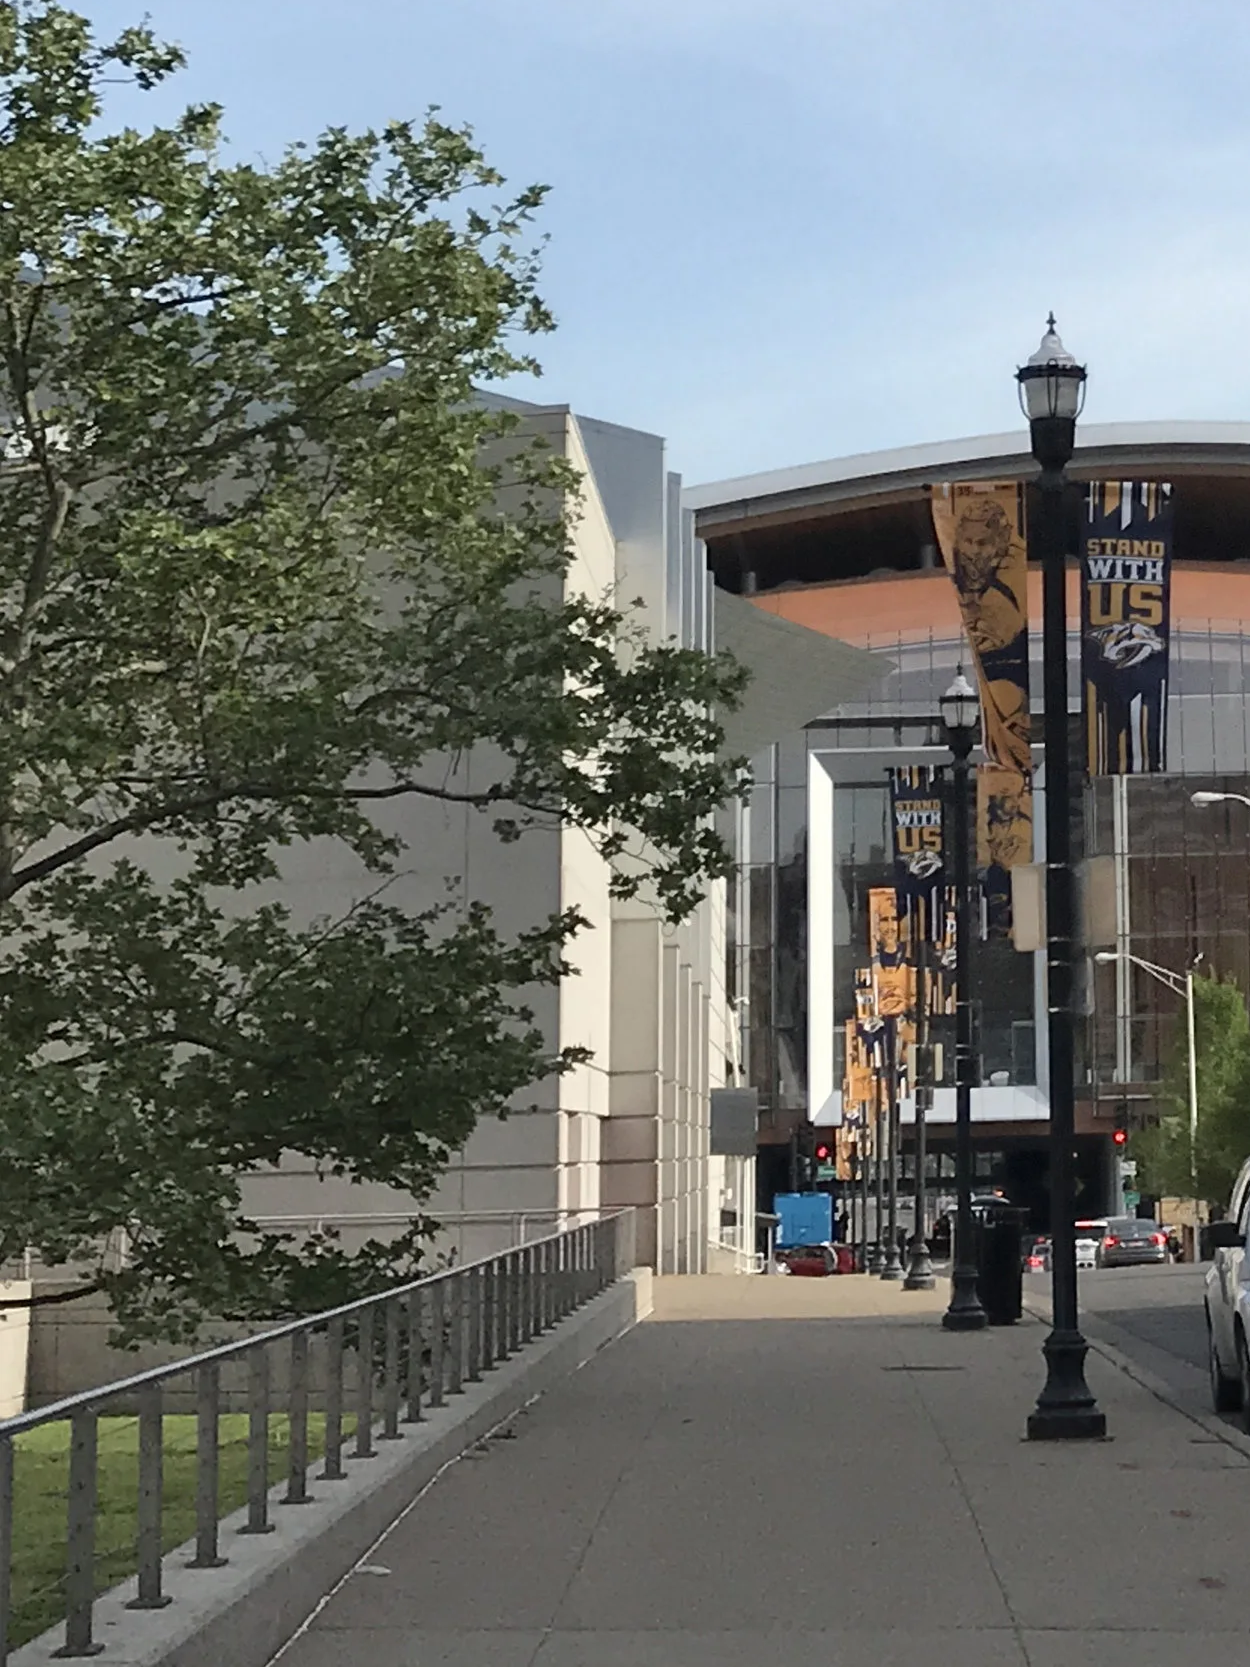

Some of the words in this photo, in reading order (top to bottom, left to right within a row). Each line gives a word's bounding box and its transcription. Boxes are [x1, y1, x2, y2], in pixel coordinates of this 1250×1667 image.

[1087, 538, 1165, 558] STAND
[1088, 559, 1164, 581] WITH
[1087, 583, 1163, 626] US
[894, 799, 941, 811] STAND
[896, 812, 942, 826] WITH
[896, 826, 942, 854] US
